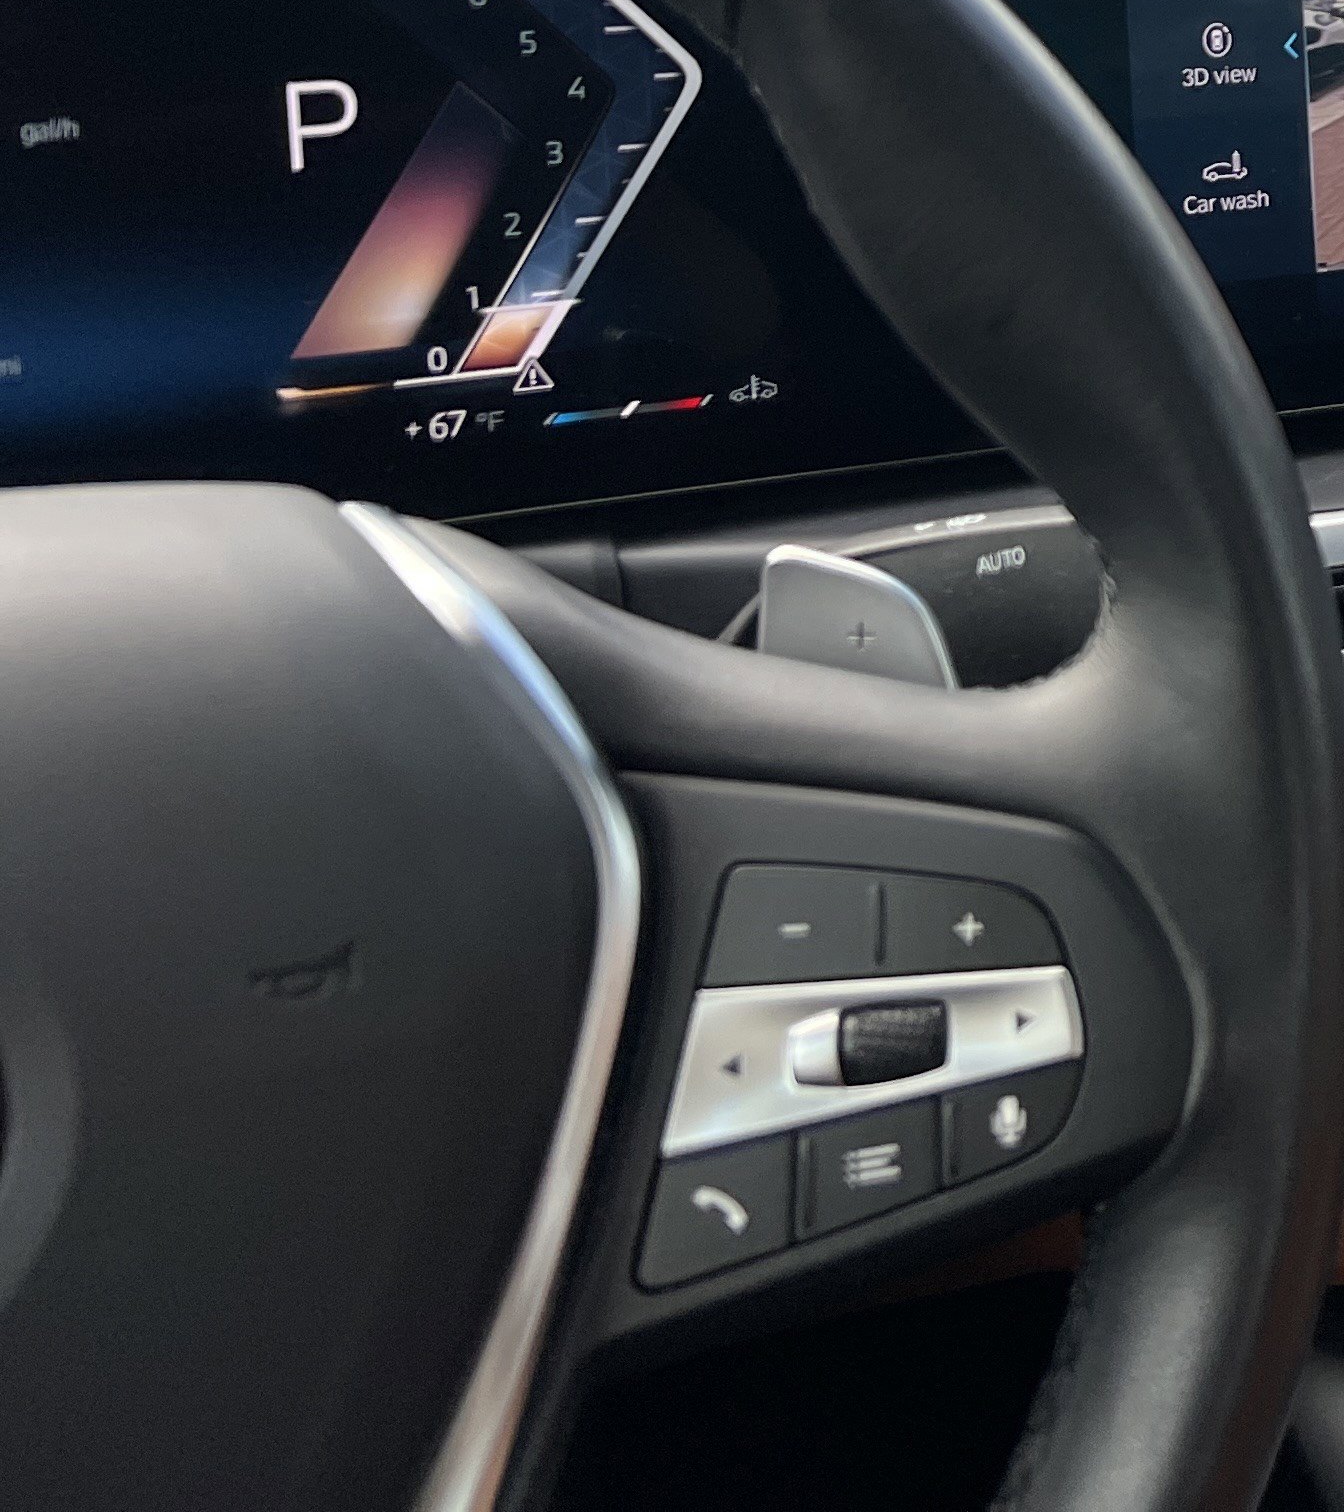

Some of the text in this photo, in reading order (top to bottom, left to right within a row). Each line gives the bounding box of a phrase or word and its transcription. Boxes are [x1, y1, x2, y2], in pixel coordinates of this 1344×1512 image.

[519, 30, 538, 55] 5
[567, 75, 586, 101] 4
[1181, 65, 1258, 87] 3D view
[284, 79, 359, 174] P
[545, 140, 564, 166] 3
[1183, 189, 1270, 216] Car wash
[503, 211, 522, 237] 2
[465, 285, 480, 311] 1
[426, 345, 448, 373] 0
[975, 544, 1027, 578] AUTO
